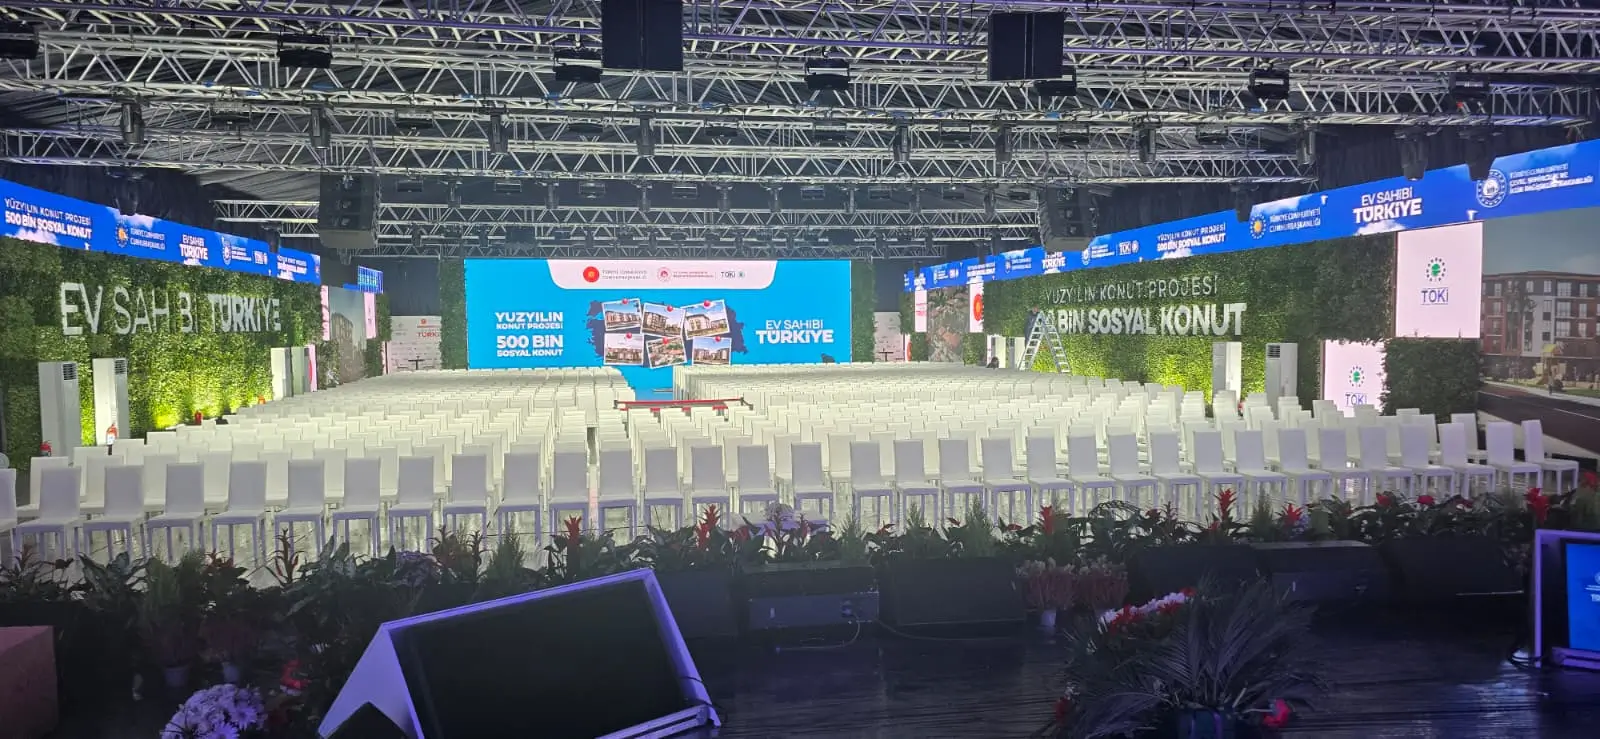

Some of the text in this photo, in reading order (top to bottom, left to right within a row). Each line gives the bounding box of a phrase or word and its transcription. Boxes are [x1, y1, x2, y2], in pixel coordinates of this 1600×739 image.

[1361, 193, 1376, 206] EV
[5, 210, 21, 225] 500
[1352, 198, 1422, 223] TÜRKİYE
[59, 282, 103, 336] EV
[765, 319, 782, 330] EV
[1088, 305, 1157, 334] SOSYAL
[1160, 302, 1248, 336] KONUT
[496, 334, 530, 349] 500
